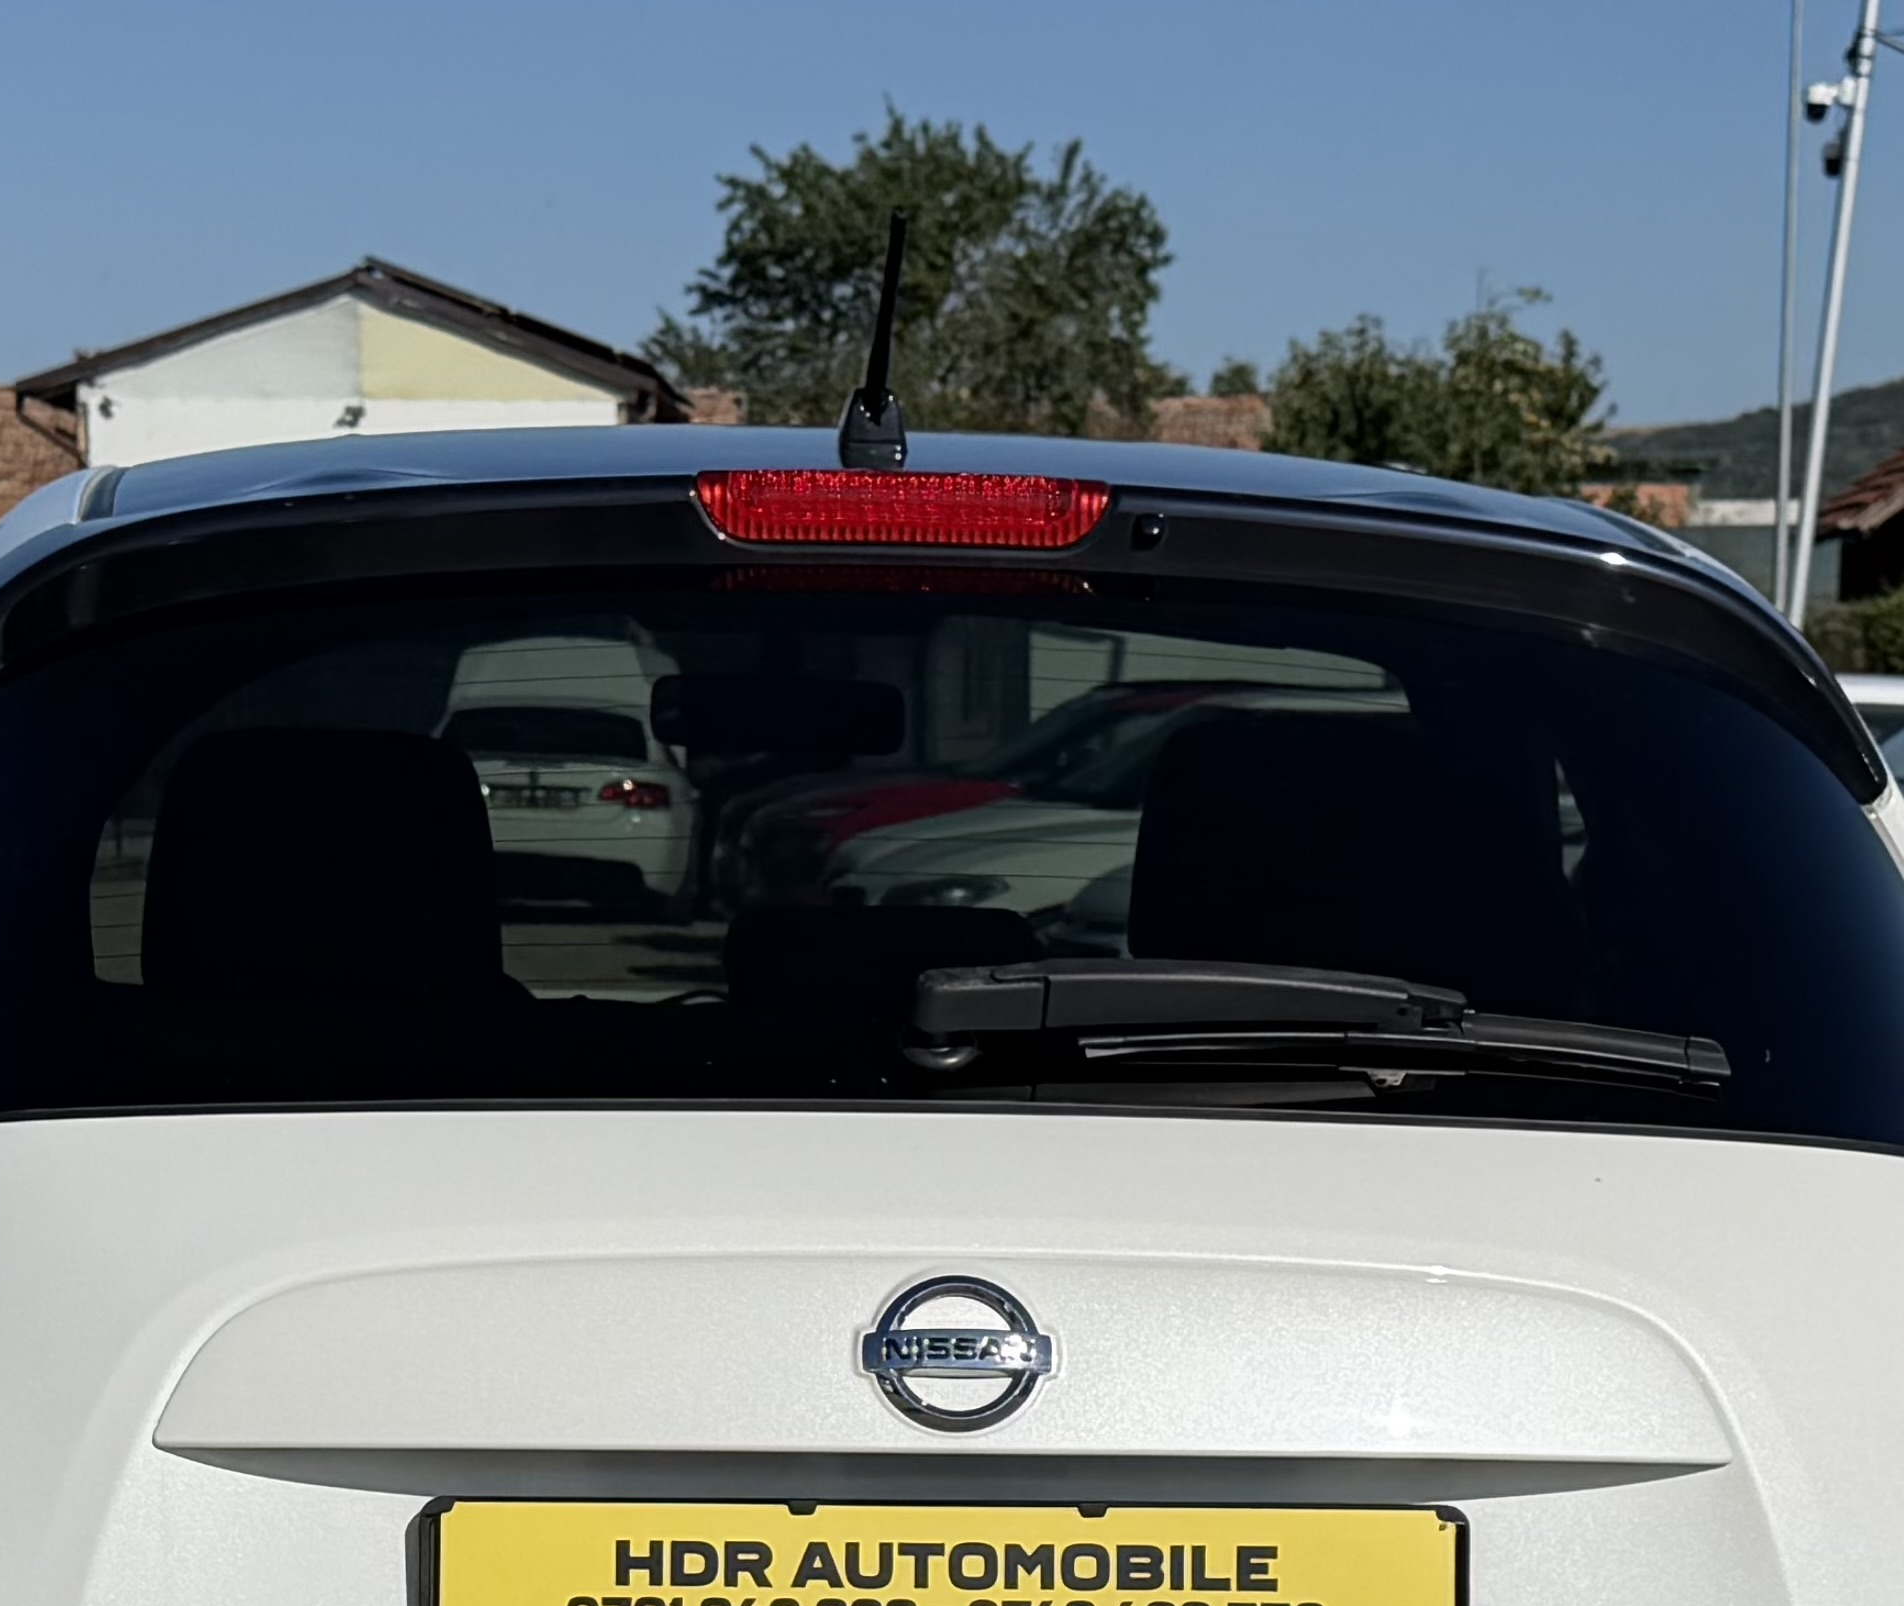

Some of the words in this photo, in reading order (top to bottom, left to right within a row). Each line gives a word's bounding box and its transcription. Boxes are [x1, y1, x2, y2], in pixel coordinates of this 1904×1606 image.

[881, 1336, 1037, 1363] NISSAN
[615, 1539, 773, 1588] HDR
[790, 1541, 1279, 1593] AUTOMOBILE
